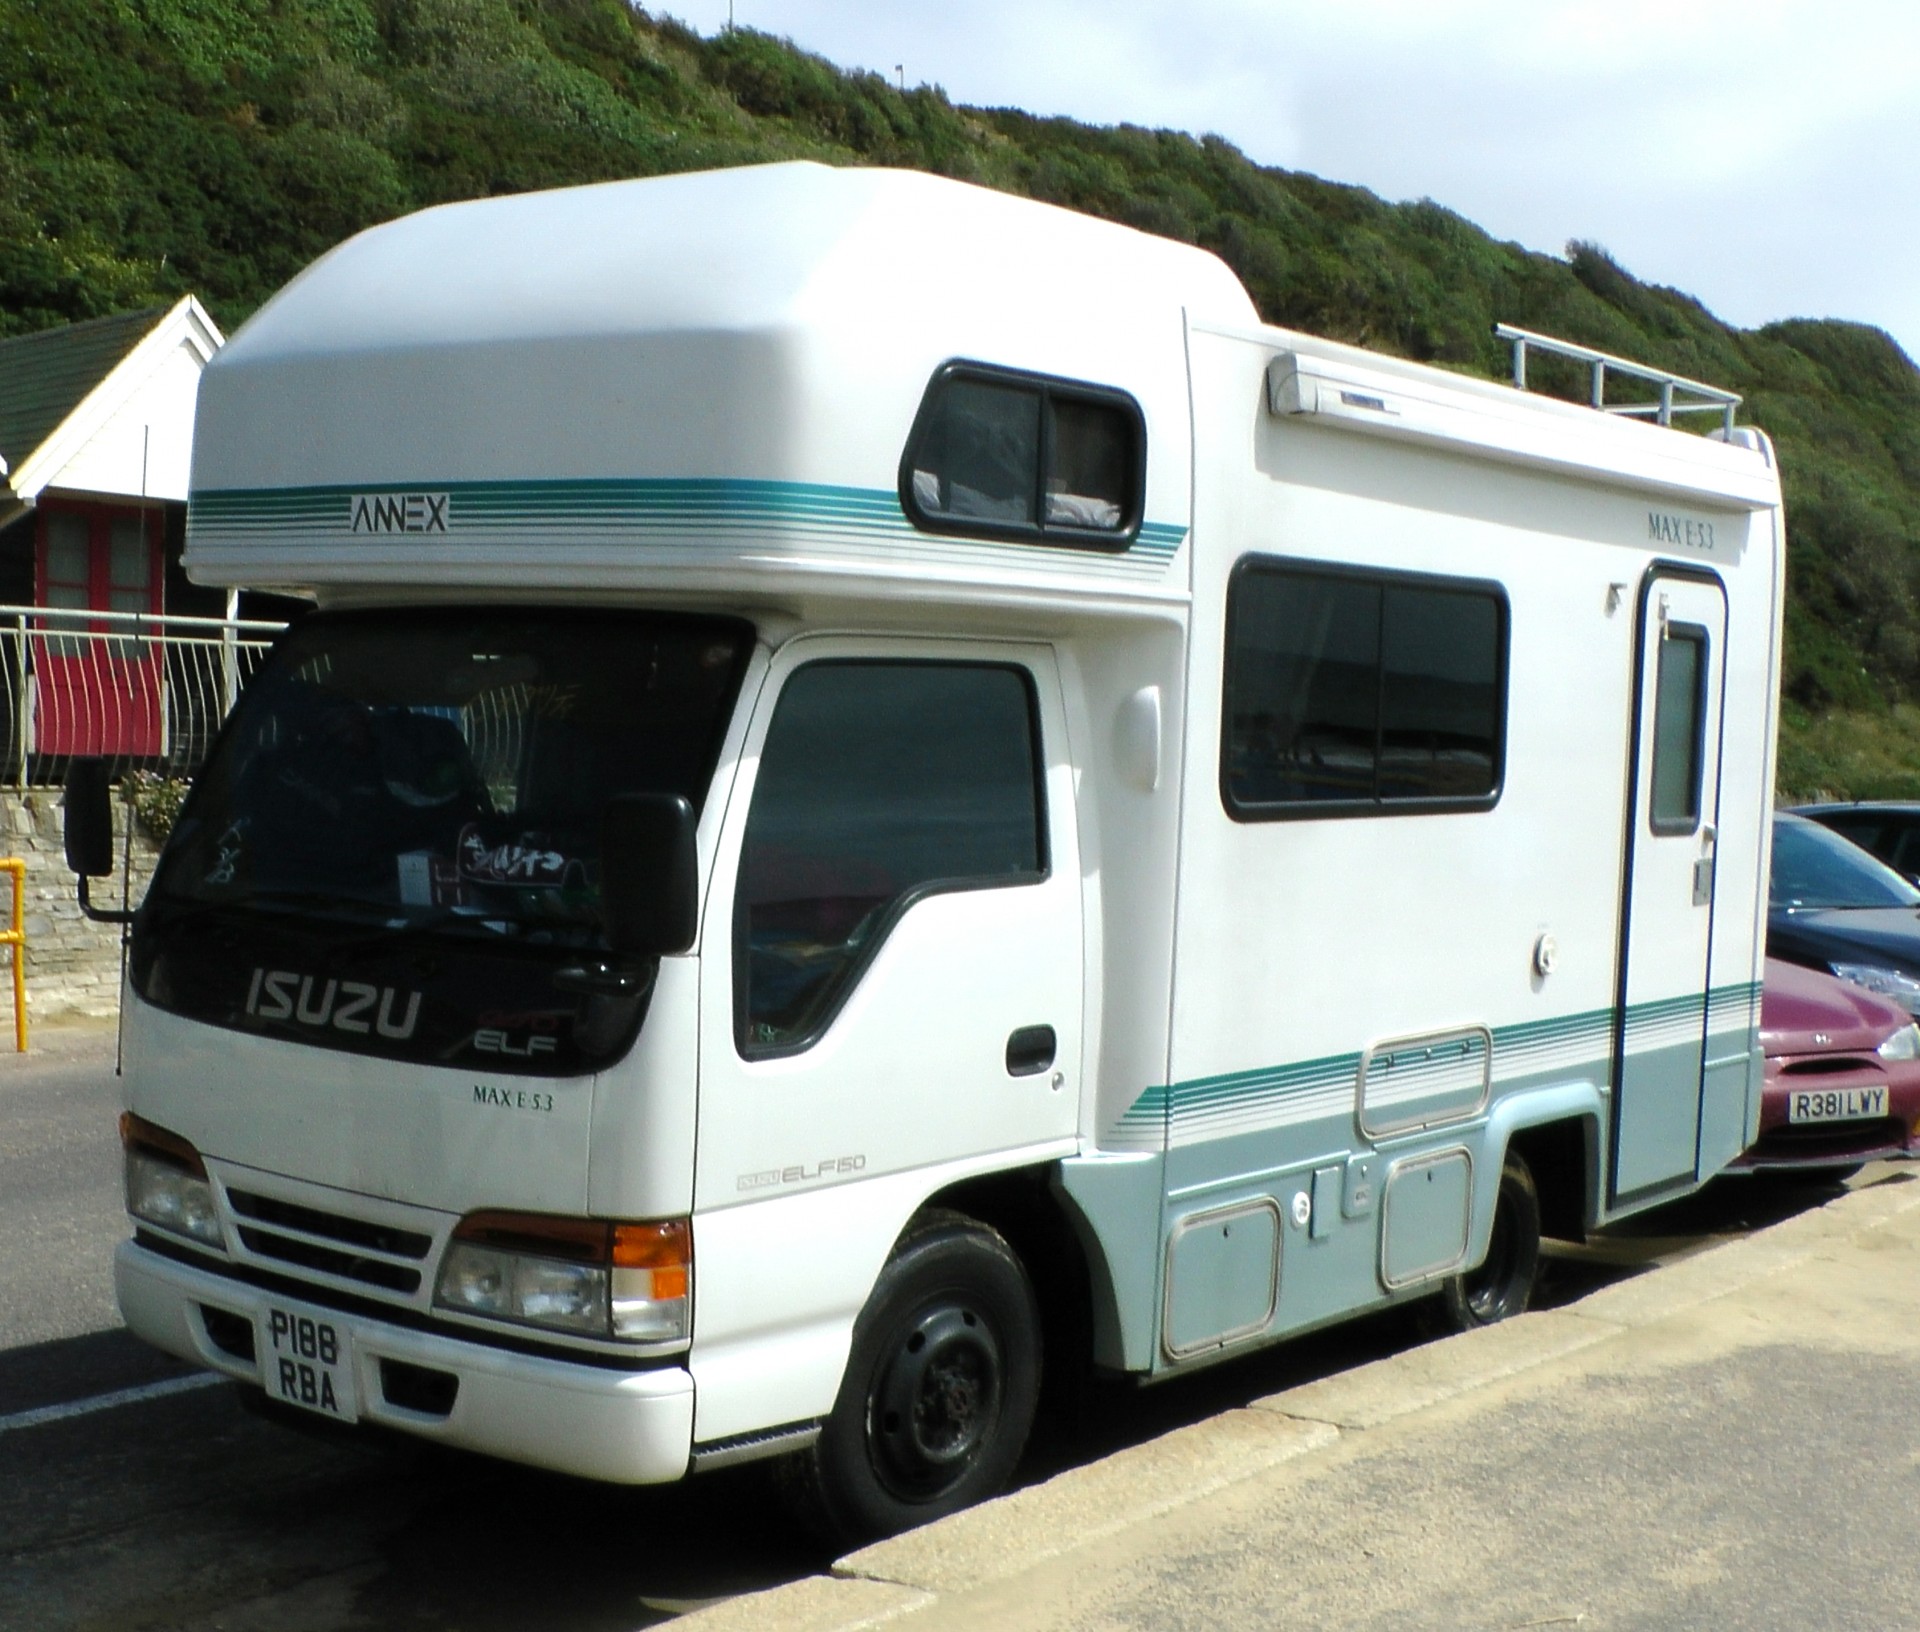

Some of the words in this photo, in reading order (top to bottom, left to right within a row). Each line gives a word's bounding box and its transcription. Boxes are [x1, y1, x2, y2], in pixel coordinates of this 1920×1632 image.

[352, 495, 446, 532] ANNEX
[1648, 512, 1681, 545] MAX
[246, 967, 423, 1040] ISUZU
[474, 1029, 558, 1056] ELF
[473, 1085, 511, 1107] MAX
[1797, 1093, 1843, 1118] R381
[1847, 1088, 1884, 1115] LWY
[270, 1308, 338, 1365] P188
[278, 1357, 338, 1412] RBA
